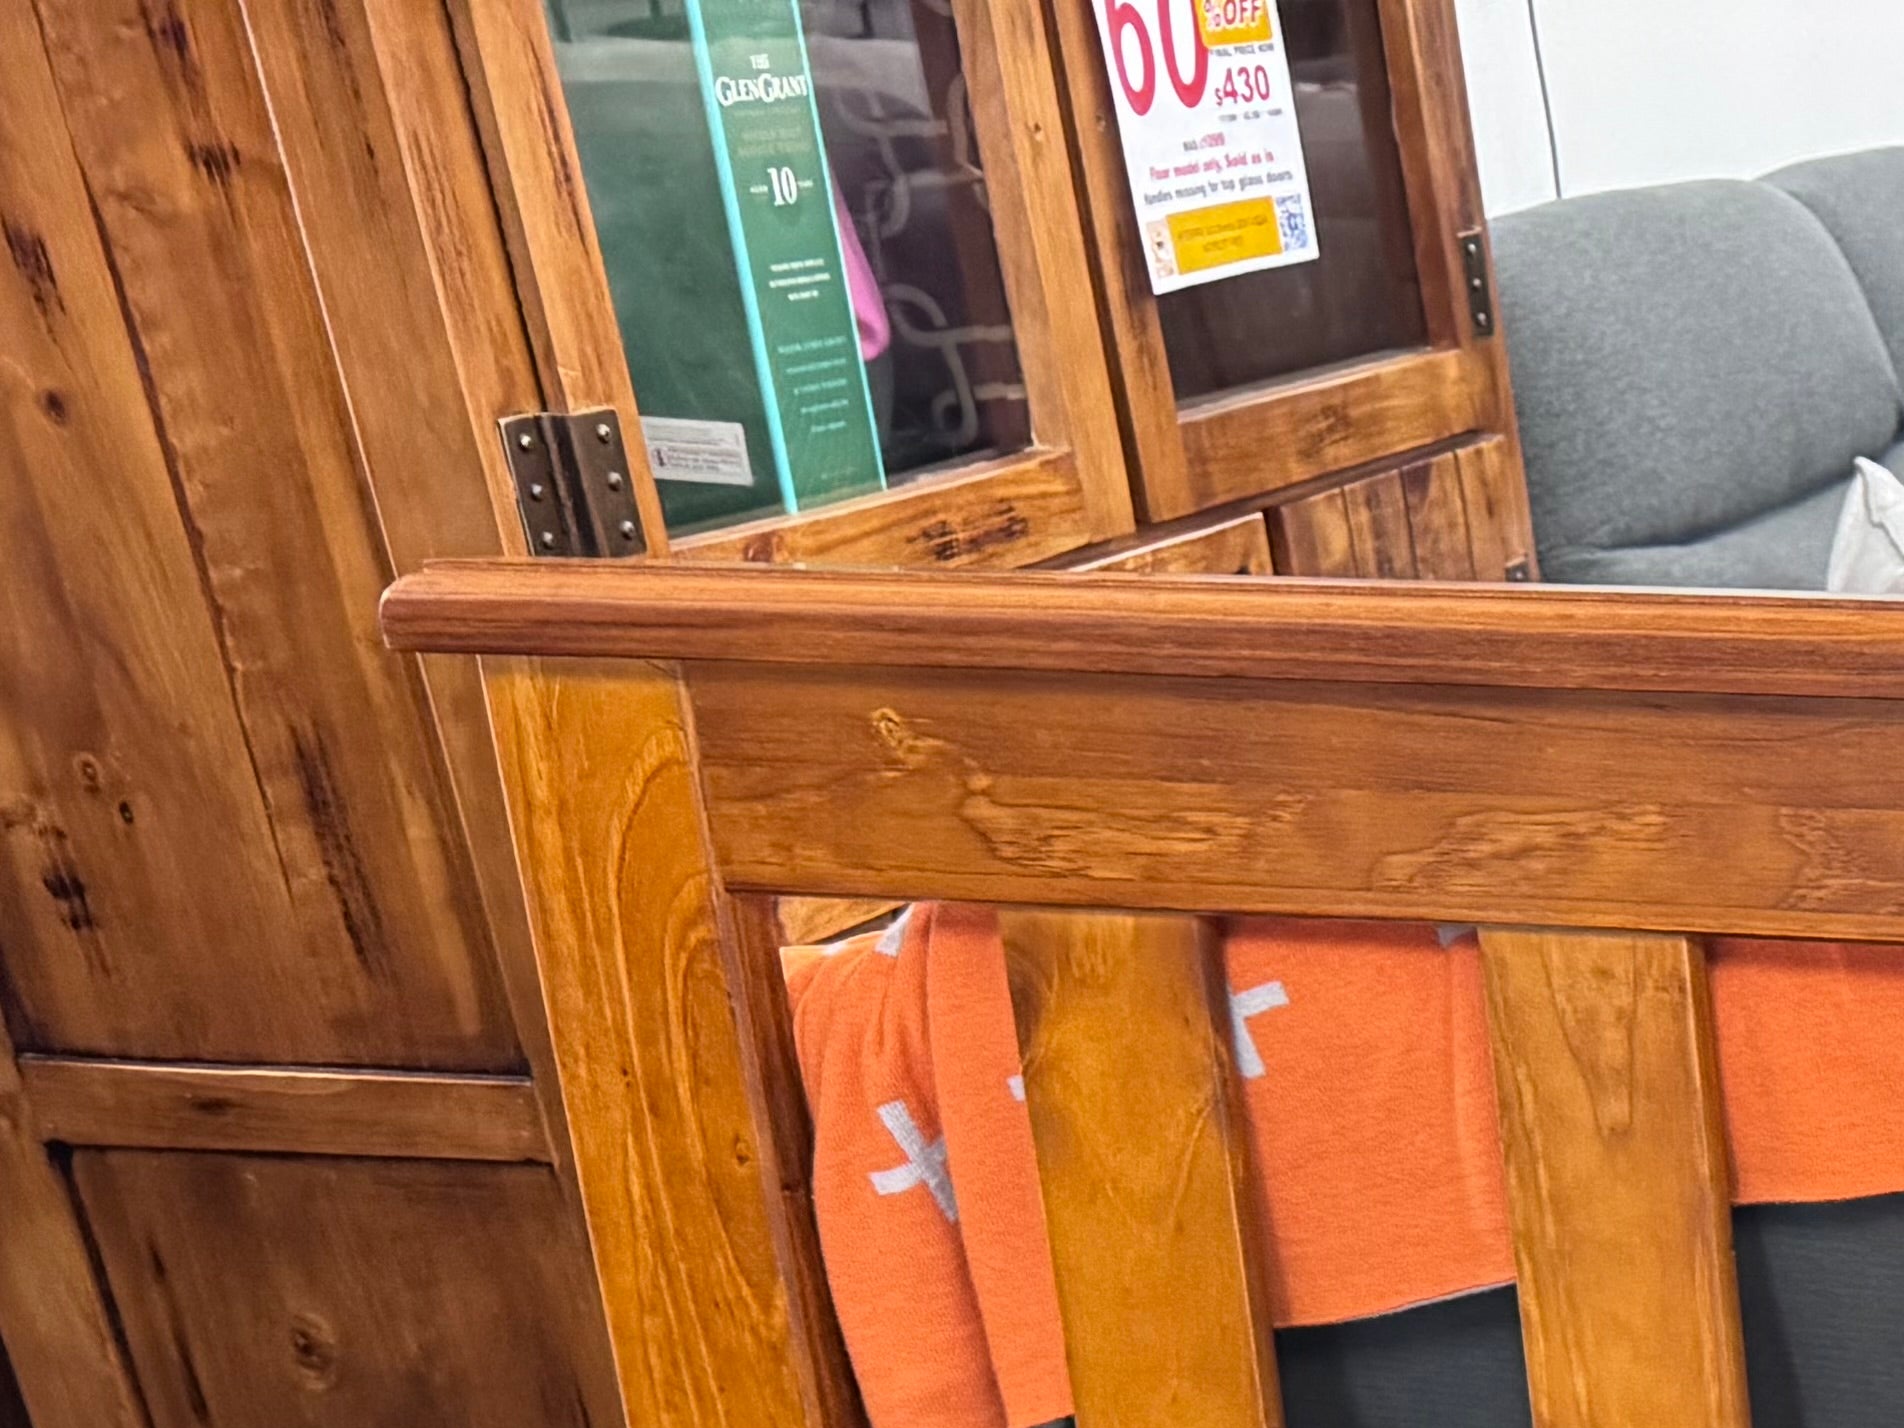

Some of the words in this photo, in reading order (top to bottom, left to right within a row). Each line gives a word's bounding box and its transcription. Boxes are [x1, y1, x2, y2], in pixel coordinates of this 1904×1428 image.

[1105, 0, 1209, 116] 60
[1215, 65, 1270, 106] $430
[767, 167, 797, 206] 10
